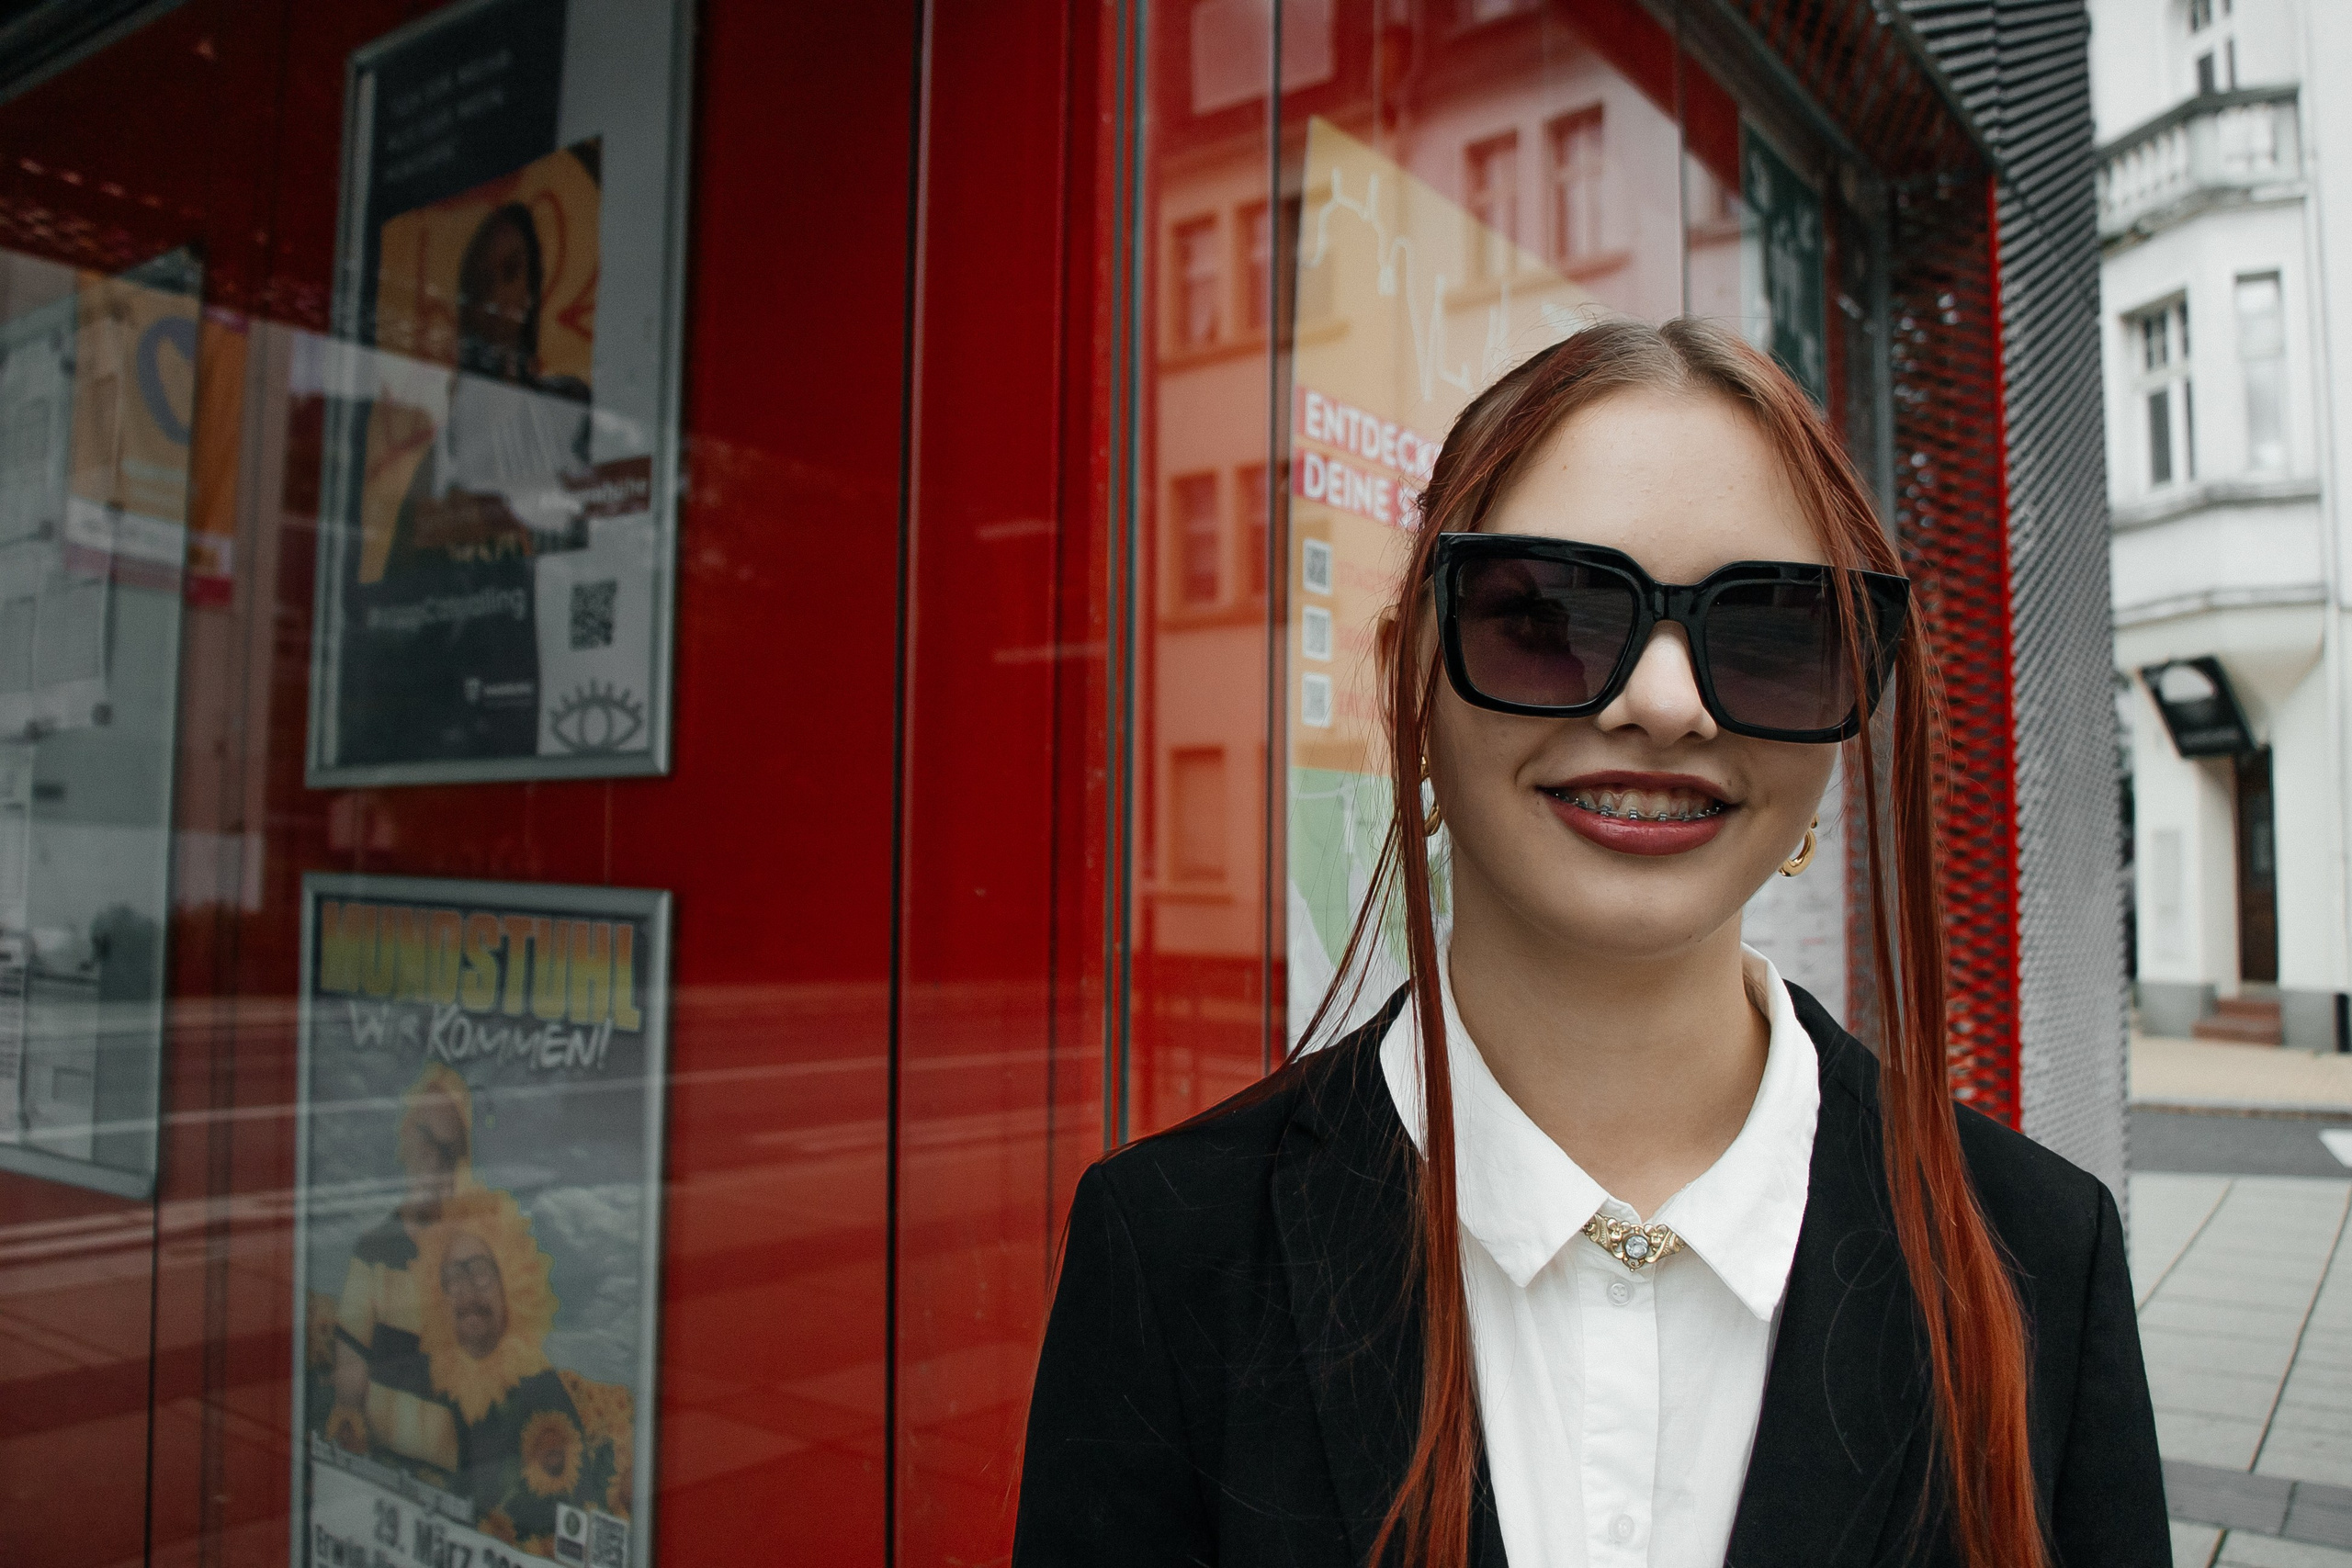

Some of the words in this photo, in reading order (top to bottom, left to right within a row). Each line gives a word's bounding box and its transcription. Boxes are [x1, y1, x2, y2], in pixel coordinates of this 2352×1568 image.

[1304, 452, 1389, 523] DEINE
[321, 900, 641, 1032] MUNDSTUHL
[428, 1003, 614, 1069] KOMMEN!
